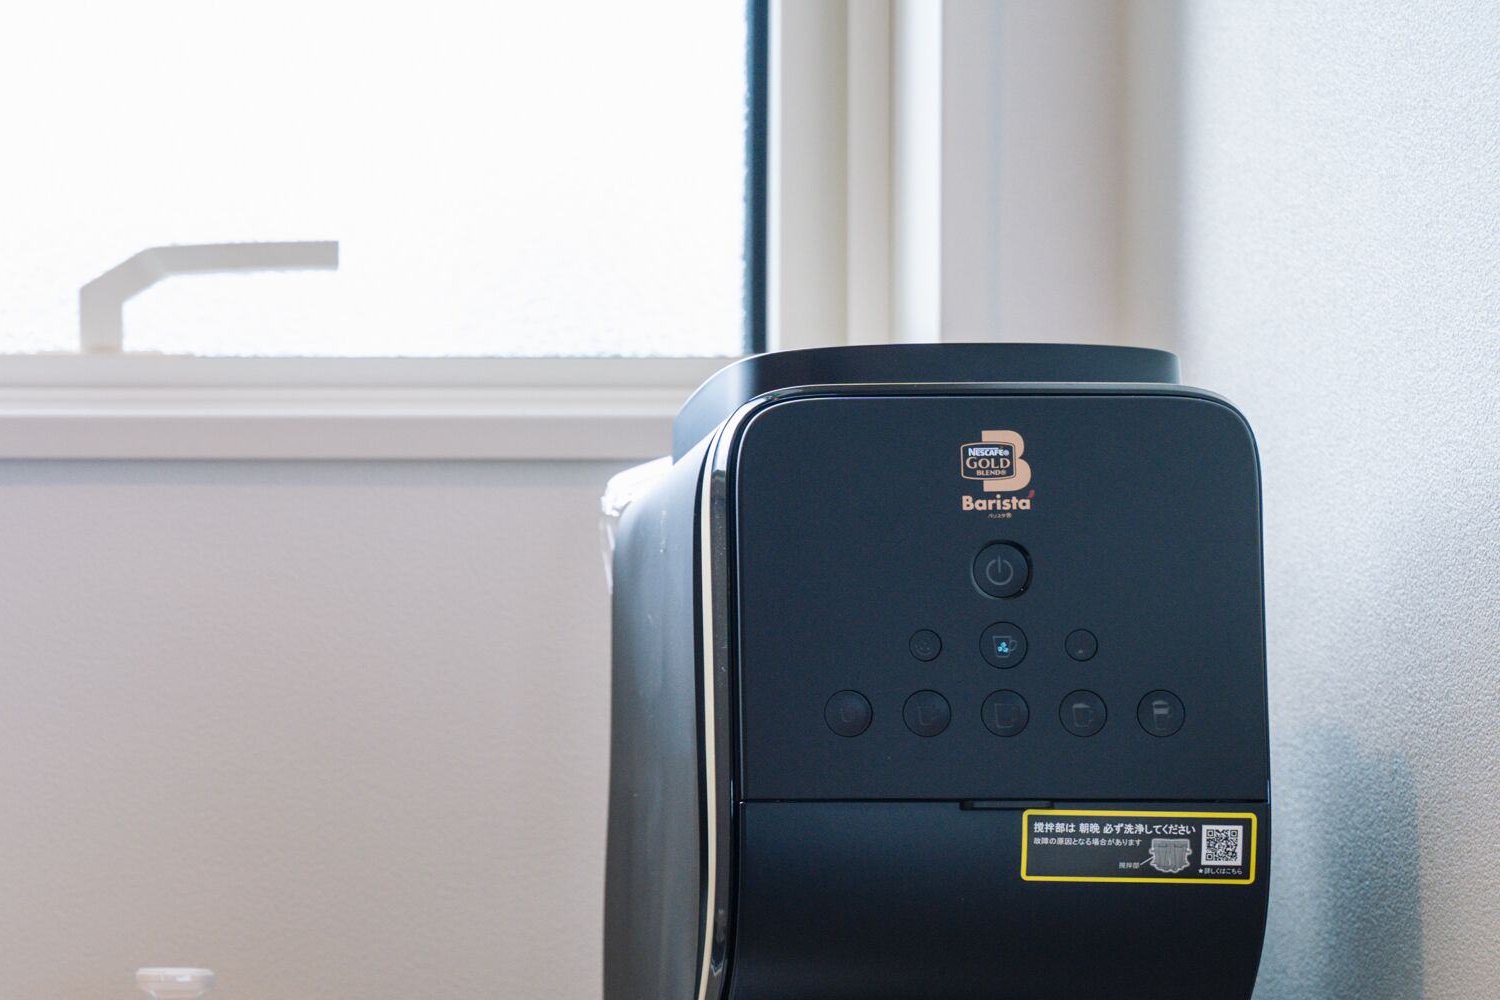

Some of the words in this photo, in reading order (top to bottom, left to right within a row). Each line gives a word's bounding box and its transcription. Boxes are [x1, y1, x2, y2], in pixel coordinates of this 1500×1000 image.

[965, 456, 1011, 469] GOLD
[1079, 822, 1100, 834] 朝晩
[1103, 823, 1197, 835] 必ず洗浄してください
[1033, 837, 1142, 847] 故障の原因となる場合があります
